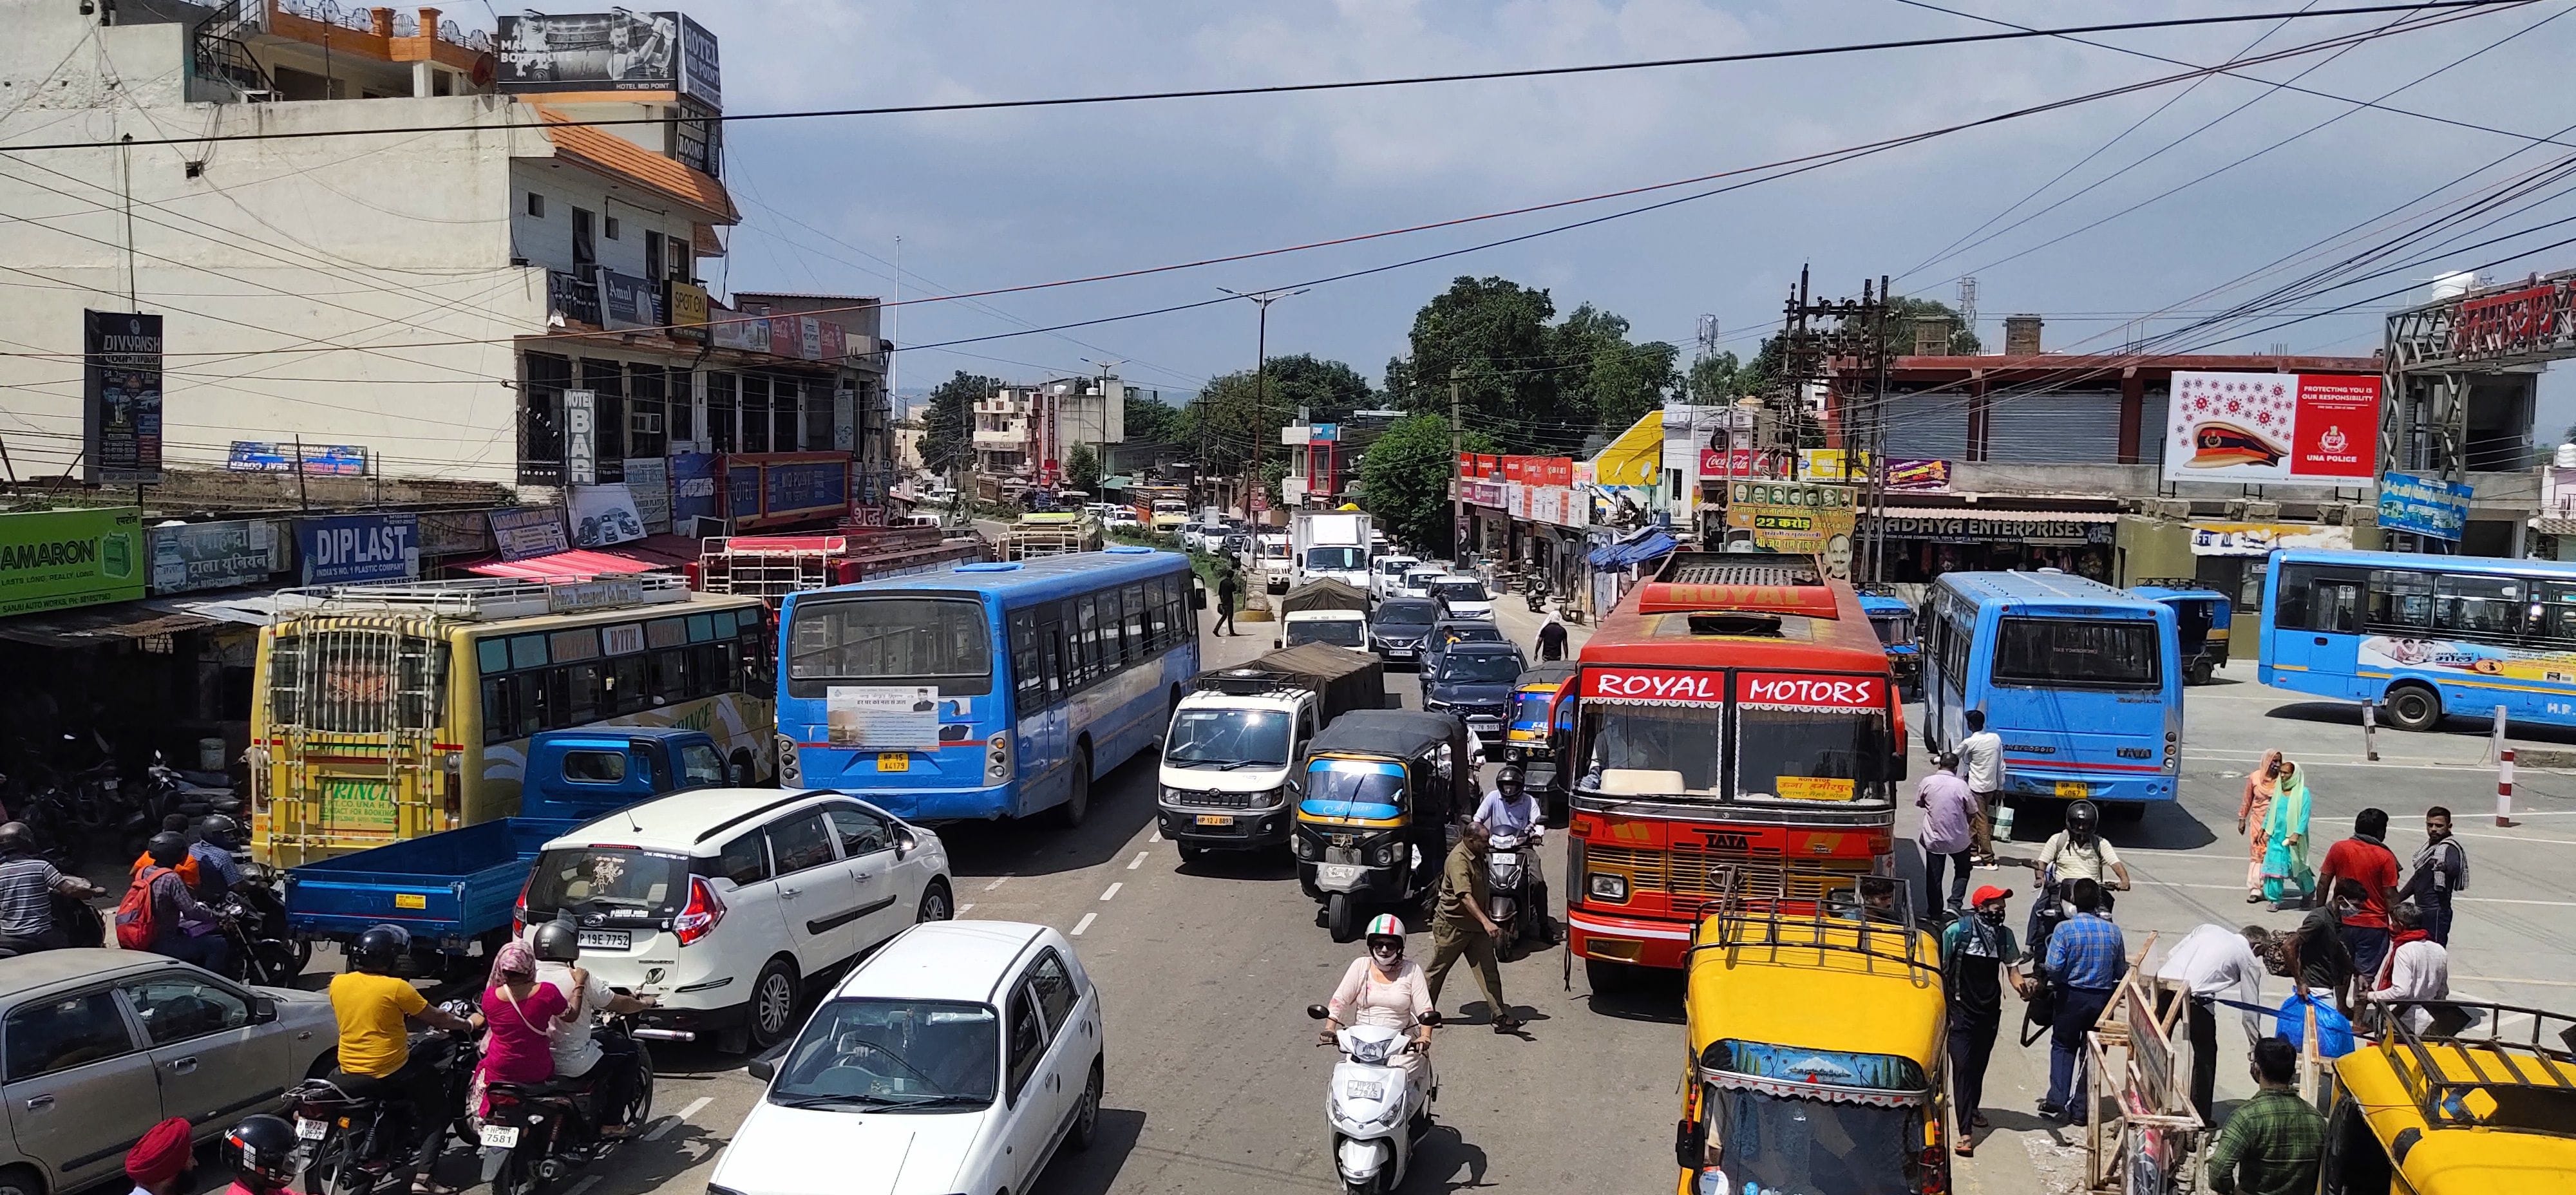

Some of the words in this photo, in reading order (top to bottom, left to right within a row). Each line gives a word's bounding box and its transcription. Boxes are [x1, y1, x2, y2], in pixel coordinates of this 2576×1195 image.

[685, 24, 719, 69] HOTEL
[686, 52, 698, 73] MID
[698, 61, 720, 86] POINT
[681, 106, 705, 131] BAR
[679, 135, 704, 159] ROOMS
[609, 279, 632, 302] Amul
[675, 291, 693, 312] SPOT
[694, 296, 705, 315] ON
[104, 335, 160, 353] DIVYANSH
[565, 390, 593, 408] HOTEL
[571, 409, 591, 482] BAR
[231, 461, 262, 471] COVER
[267, 462, 290, 471] SEAT
[1756, 517, 1775, 527] 22
[1969, 520, 2086, 538] ENTERPRISES
[317, 526, 408, 567] DIPLAST
[1755, 536, 1766, 549] श्री
[1767, 538, 1781, 549] जय
[1783, 538, 1795, 549] राम
[1, 540, 95, 570] AMARON
[222, 553, 267, 575] यूनियन
[316, 567, 338, 578] INDIA'S
[339, 567, 350, 576] NO.
[355, 565, 378, 574] PLASTIC
[379, 562, 405, 573] COMPANY
[1, 578, 24, 587] LASTS
[50, 573, 73, 581] REALLY
[1669, 585, 1806, 606] ROYAL
[3, 602, 24, 613] SANJU
[25, 599, 43, 610] AUTO
[611, 628, 637, 653] WITH
[1598, 673, 1714, 697] ROYAL
[1749, 679, 1870, 703] MOTORS
[2117, 748, 2152, 760] TATA
[321, 780, 392, 802] PRINCE
[1809, 781, 1851, 793] हमीरपुर
[364, 809, 398, 817] BOOKING
[1705, 835, 1748, 849] TATA
[588, 934, 603, 945] 19E
[607, 934, 629, 946] 7752
[487, 1134, 511, 1143] 7581
